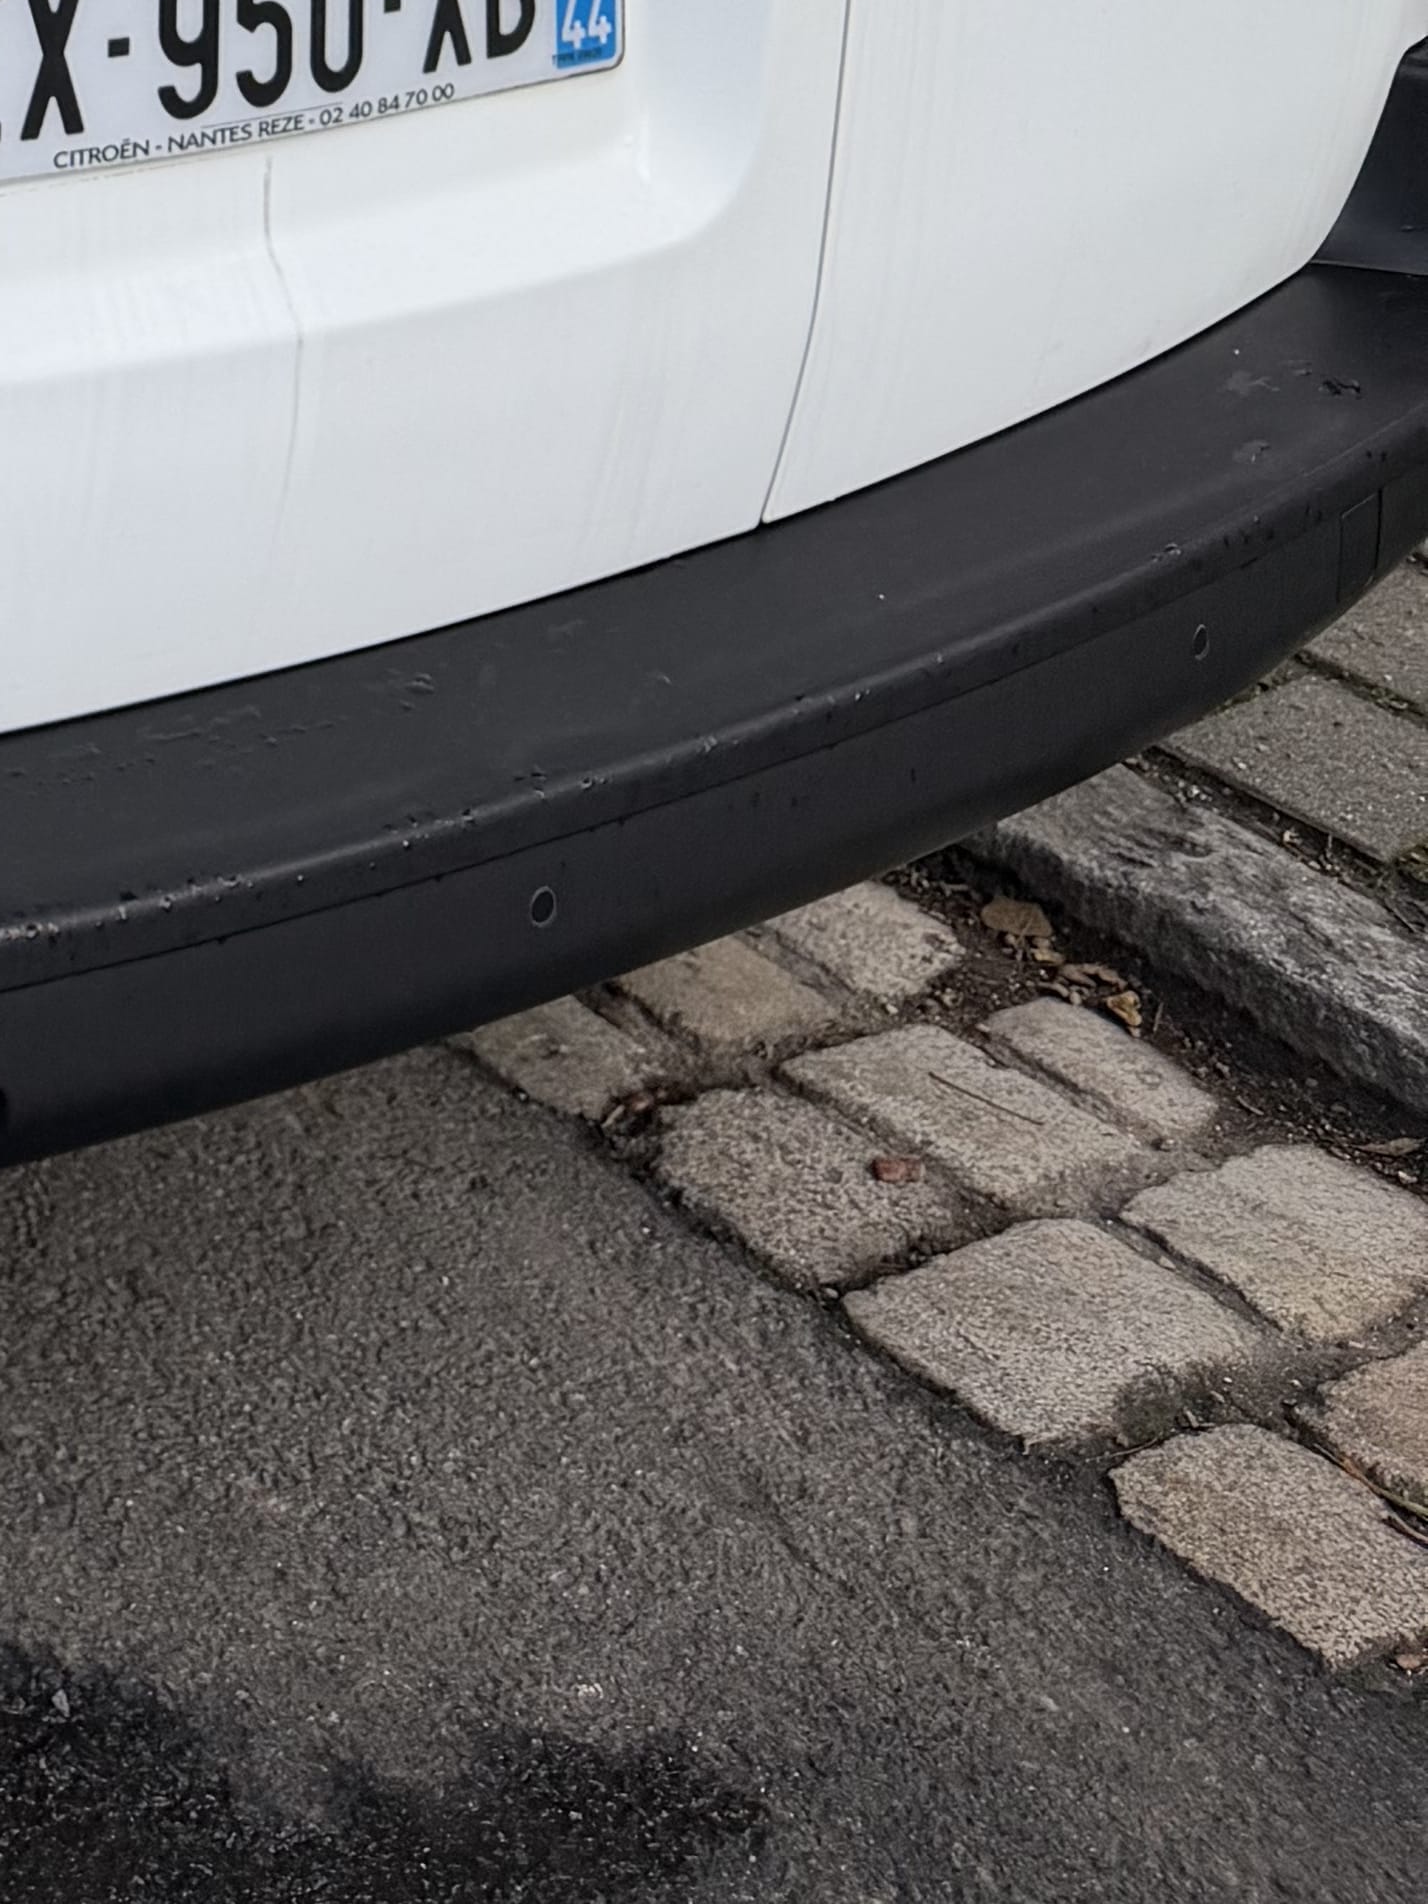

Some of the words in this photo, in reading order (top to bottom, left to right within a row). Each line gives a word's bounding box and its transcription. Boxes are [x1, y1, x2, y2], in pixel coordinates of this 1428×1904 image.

[53, 138, 150, 169] CITROËN
[168, 123, 252, 153] NANTES
[258, 114, 304, 138] REZE
[319, 106, 344, 126] 02
[349, 100, 373, 119] 40
[378, 95, 400, 114] 84
[405, 89, 428, 109] 70
[432, 82, 455, 101] 00
